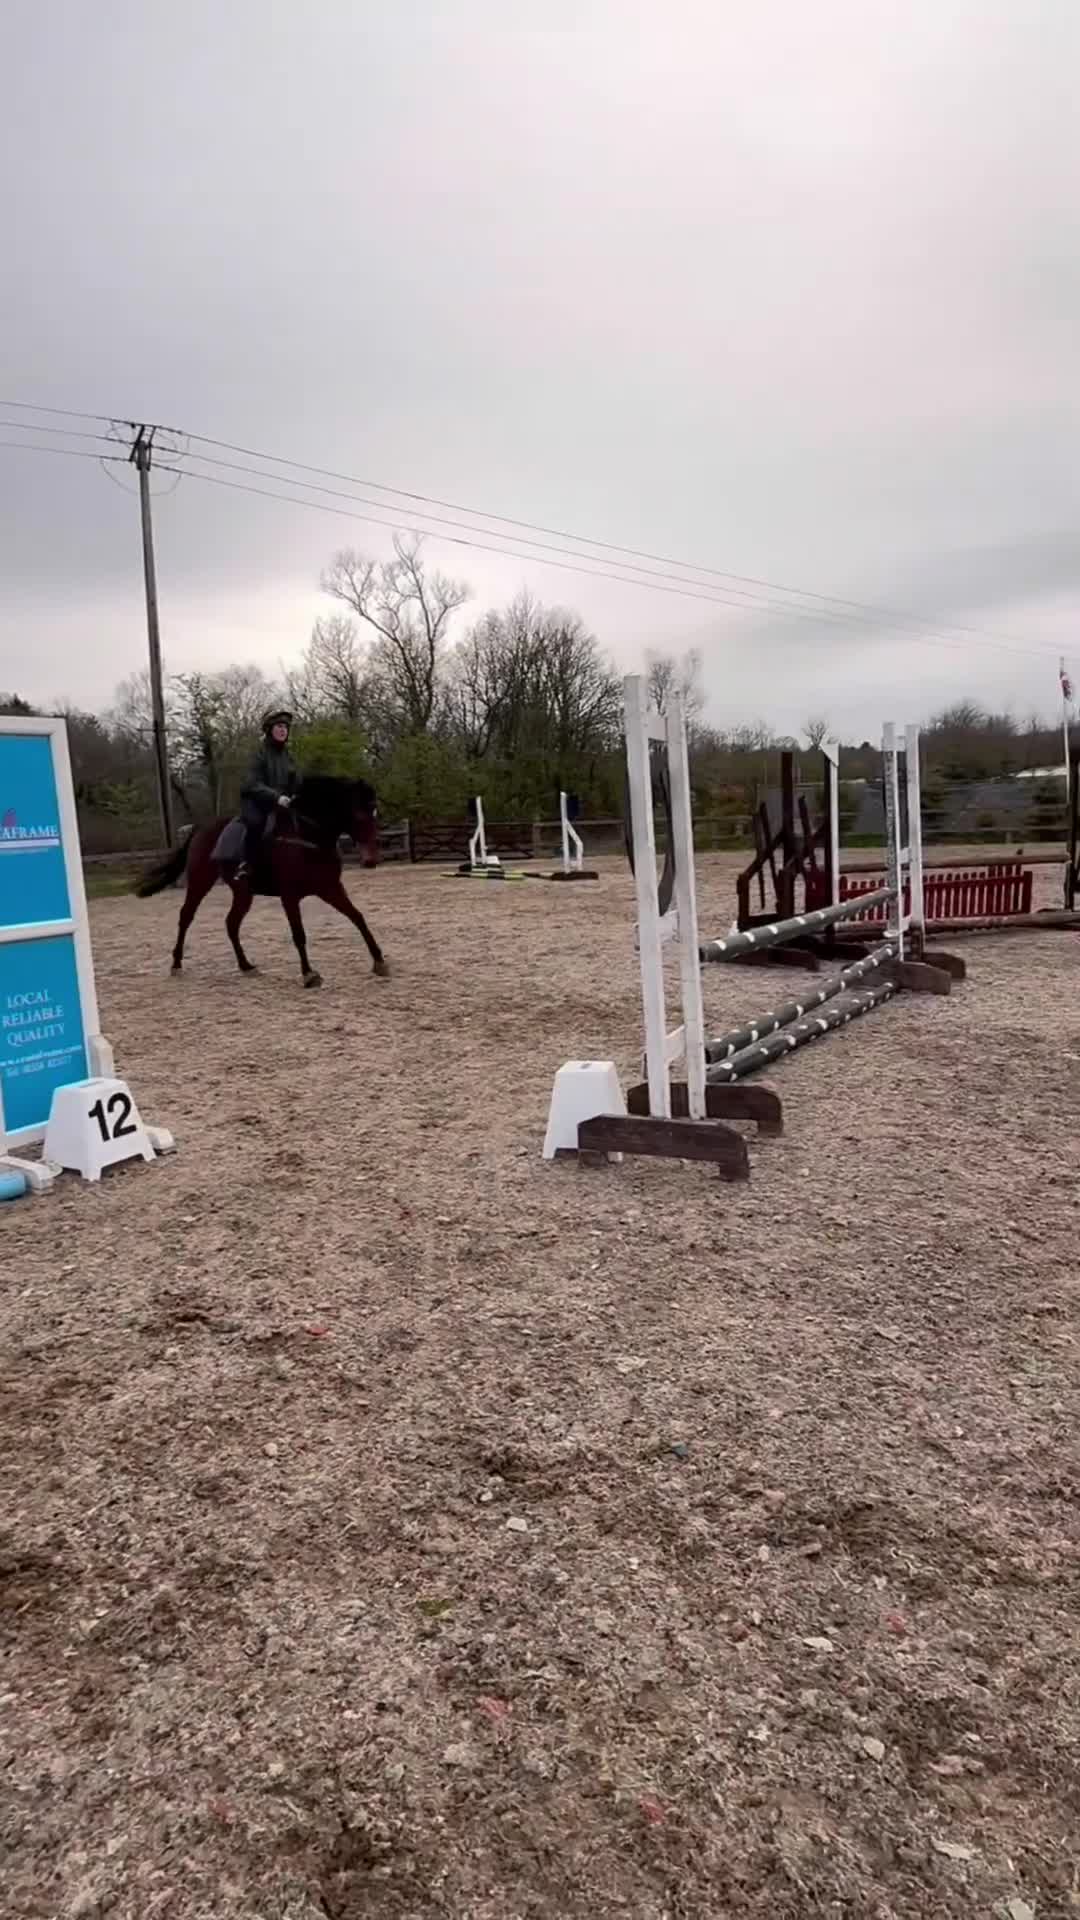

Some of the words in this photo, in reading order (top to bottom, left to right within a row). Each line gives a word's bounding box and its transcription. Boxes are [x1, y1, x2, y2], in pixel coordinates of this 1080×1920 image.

[7, 990, 51, 1009] LOCAL
[3, 1005, 64, 1027] RELIABLE
[7, 1023, 64, 1047] QUALITY
[88, 1092, 137, 1142] 12
